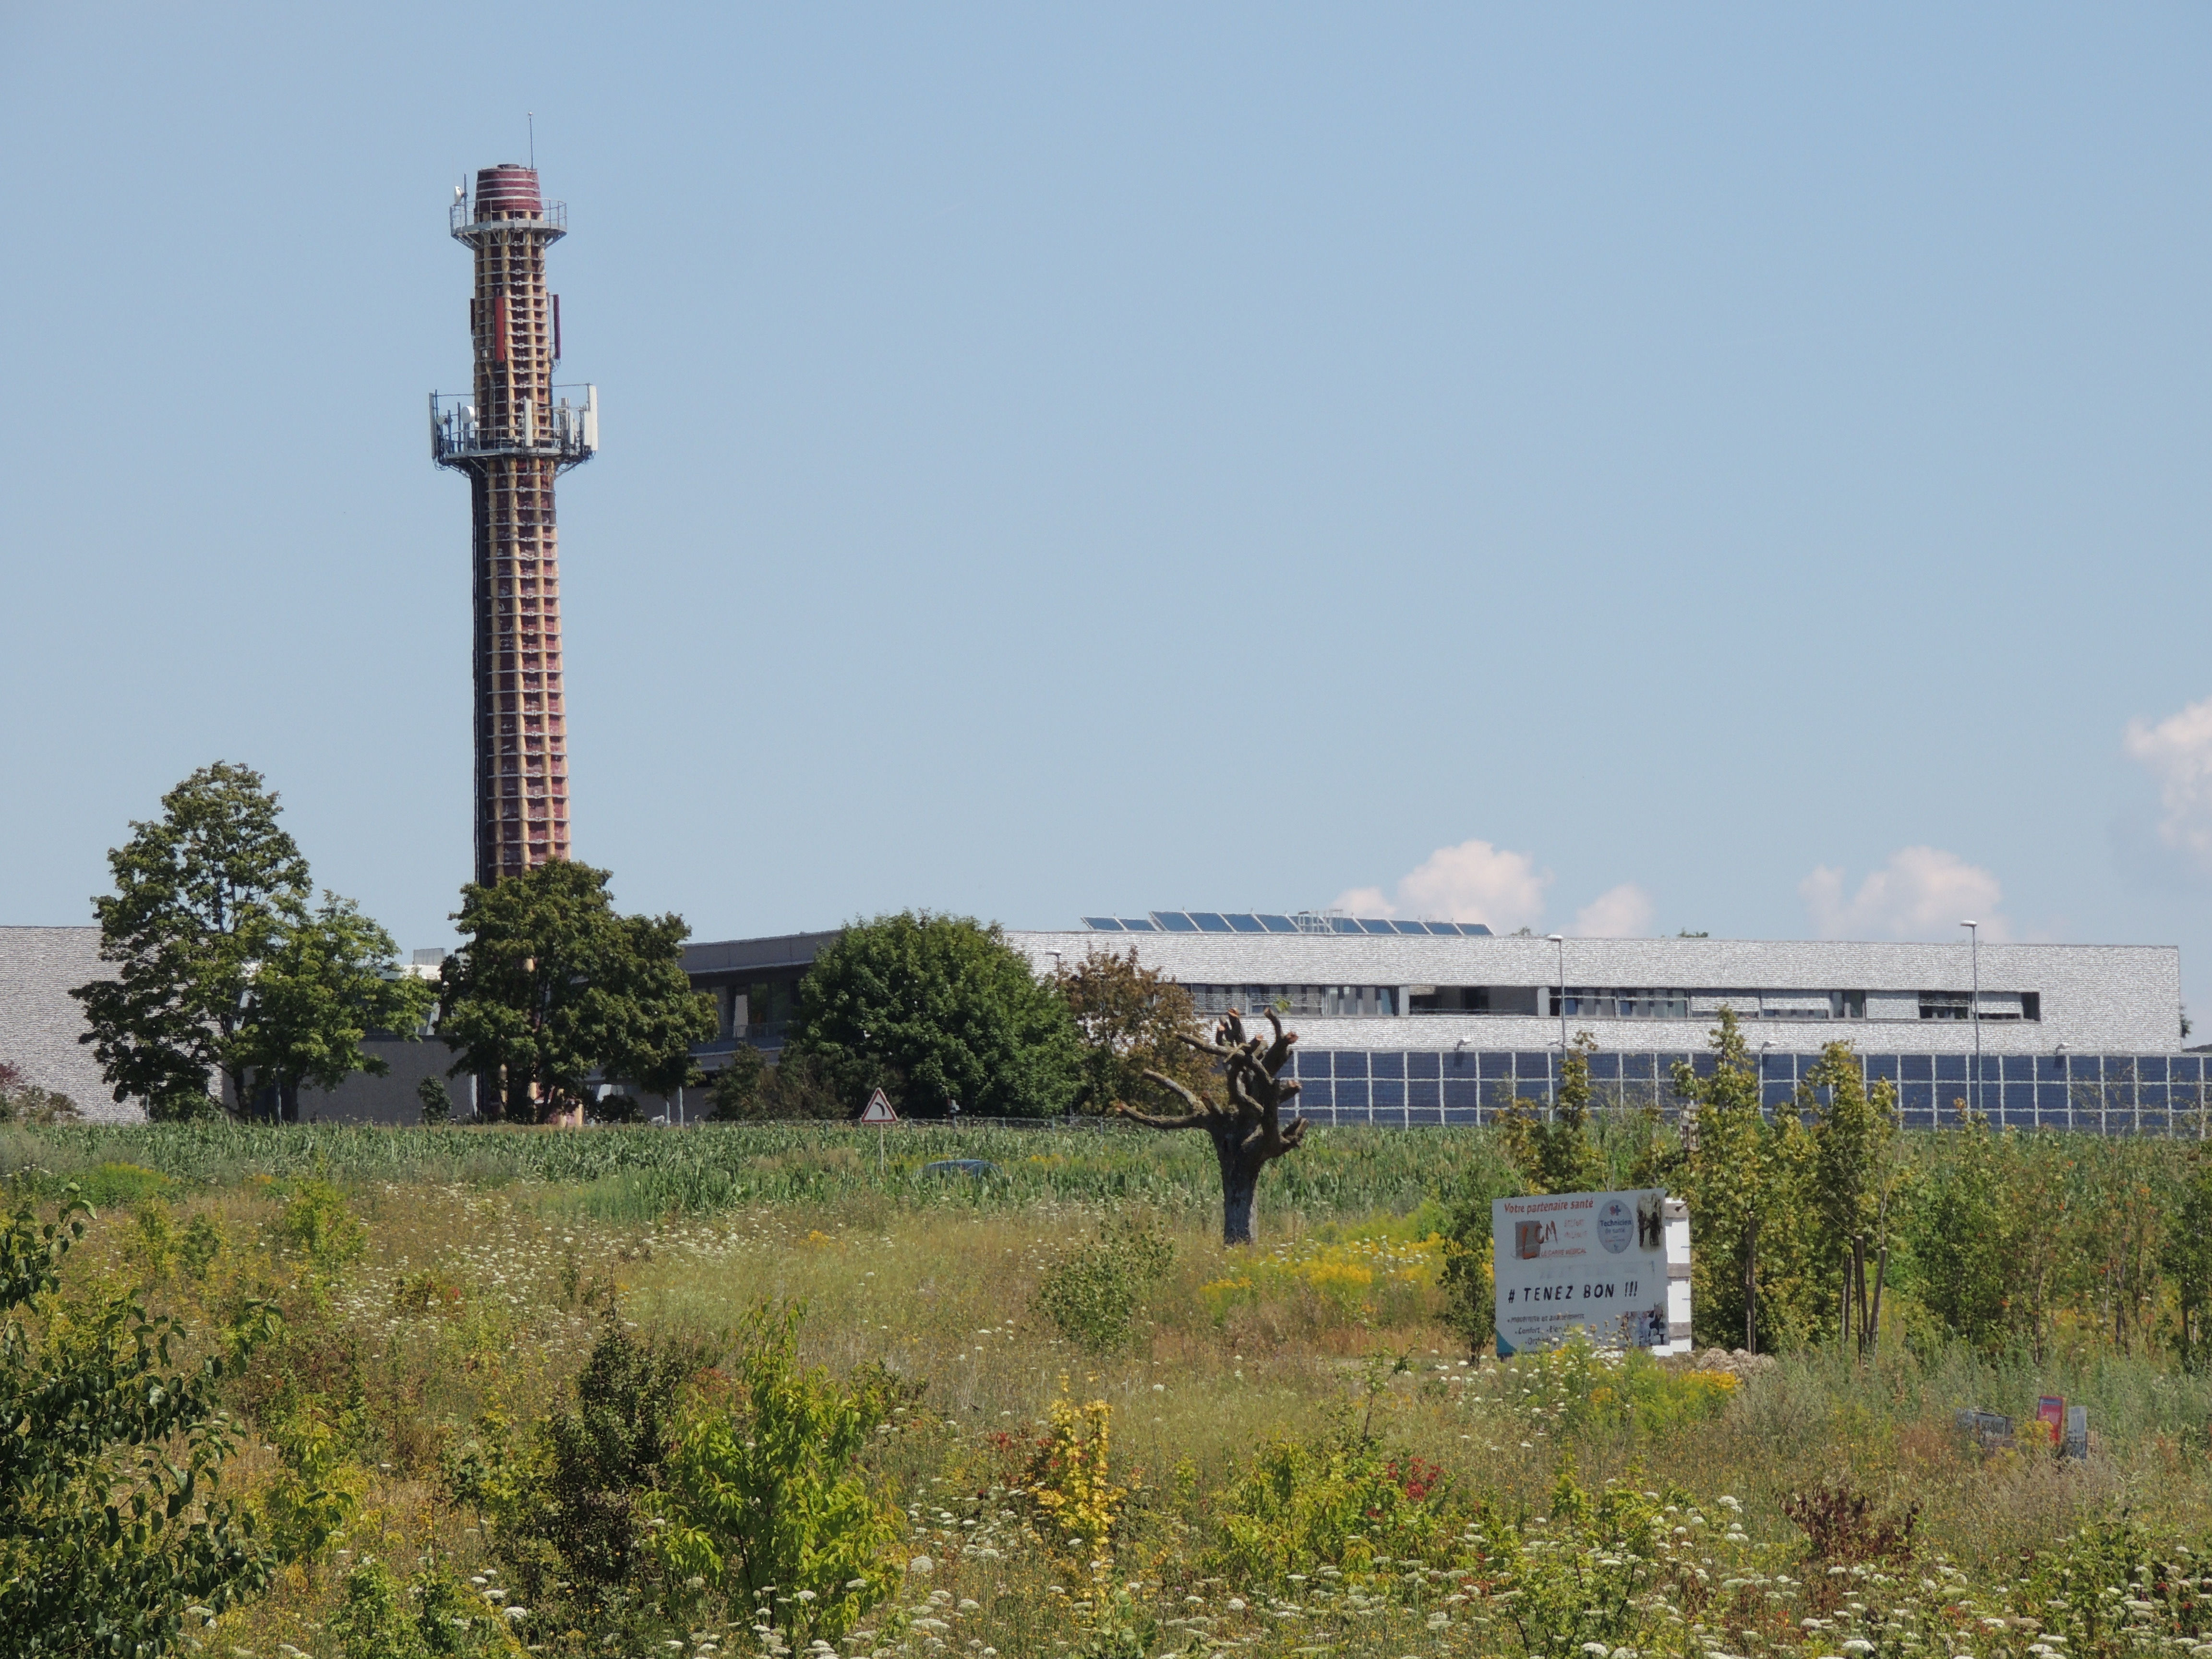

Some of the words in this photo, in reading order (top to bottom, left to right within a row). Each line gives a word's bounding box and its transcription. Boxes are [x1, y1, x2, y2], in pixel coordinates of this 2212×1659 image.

[1504, 1203, 1525, 1213] Votre
[1527, 1200, 1568, 1215] partenaire
[1570, 1197, 1593, 1209] santé
[1508, 1289, 1515, 1303] #
[1524, 1286, 1573, 1301] TENEZ
[1584, 1284, 1614, 1298] BON
[1625, 1281, 1638, 1297] !!!
